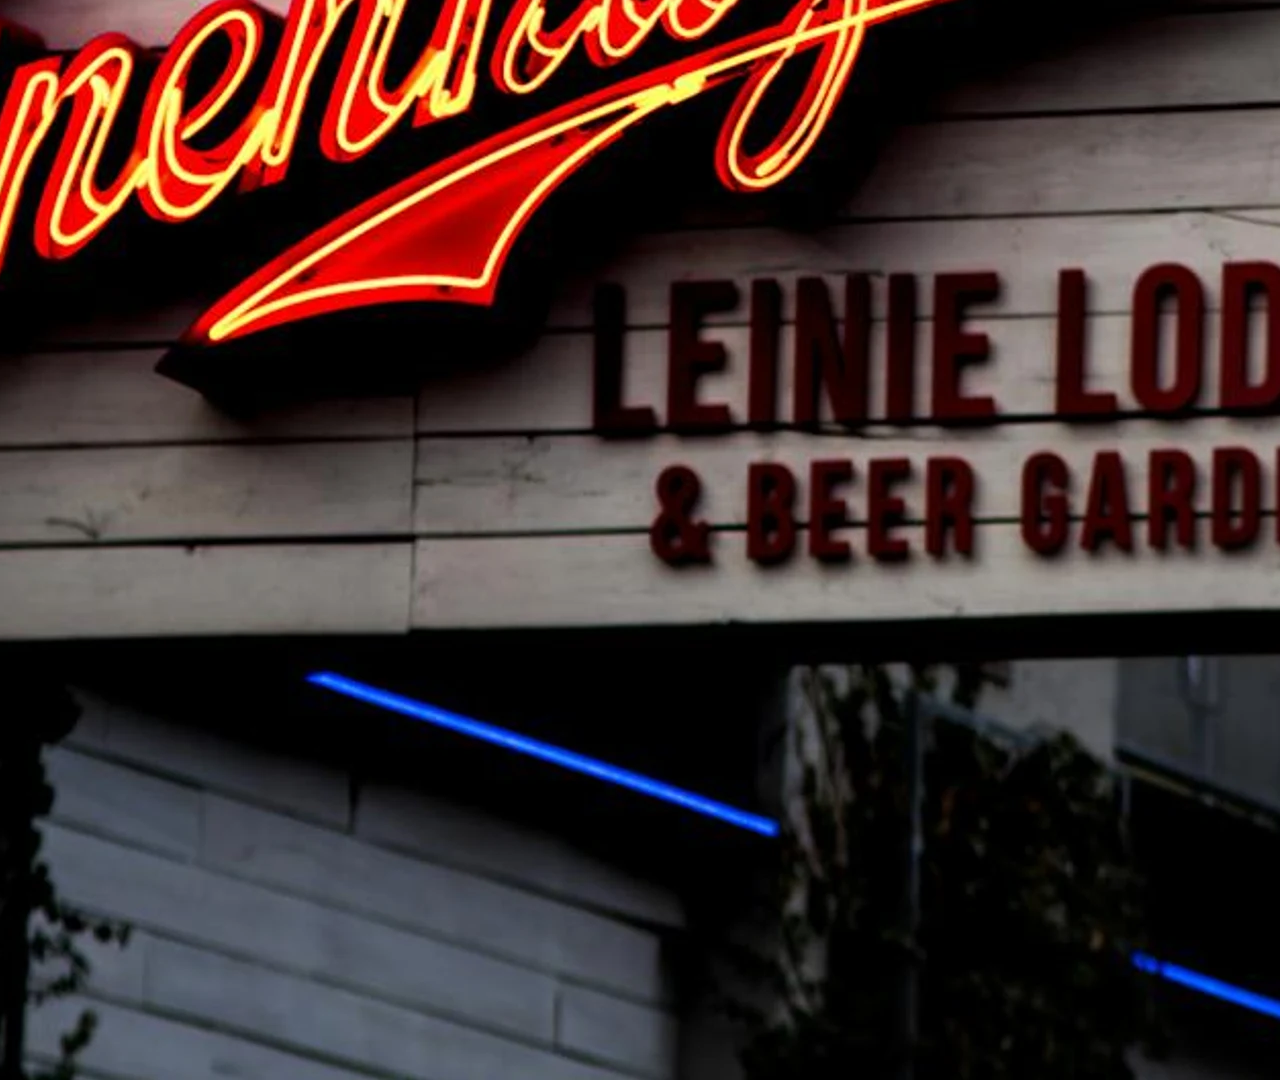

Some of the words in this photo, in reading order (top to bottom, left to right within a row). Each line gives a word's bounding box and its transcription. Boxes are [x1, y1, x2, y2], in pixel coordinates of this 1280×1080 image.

[593, 272, 1001, 437] LEINIE
[650, 466, 711, 567] &
[747, 458, 976, 565] BEER
